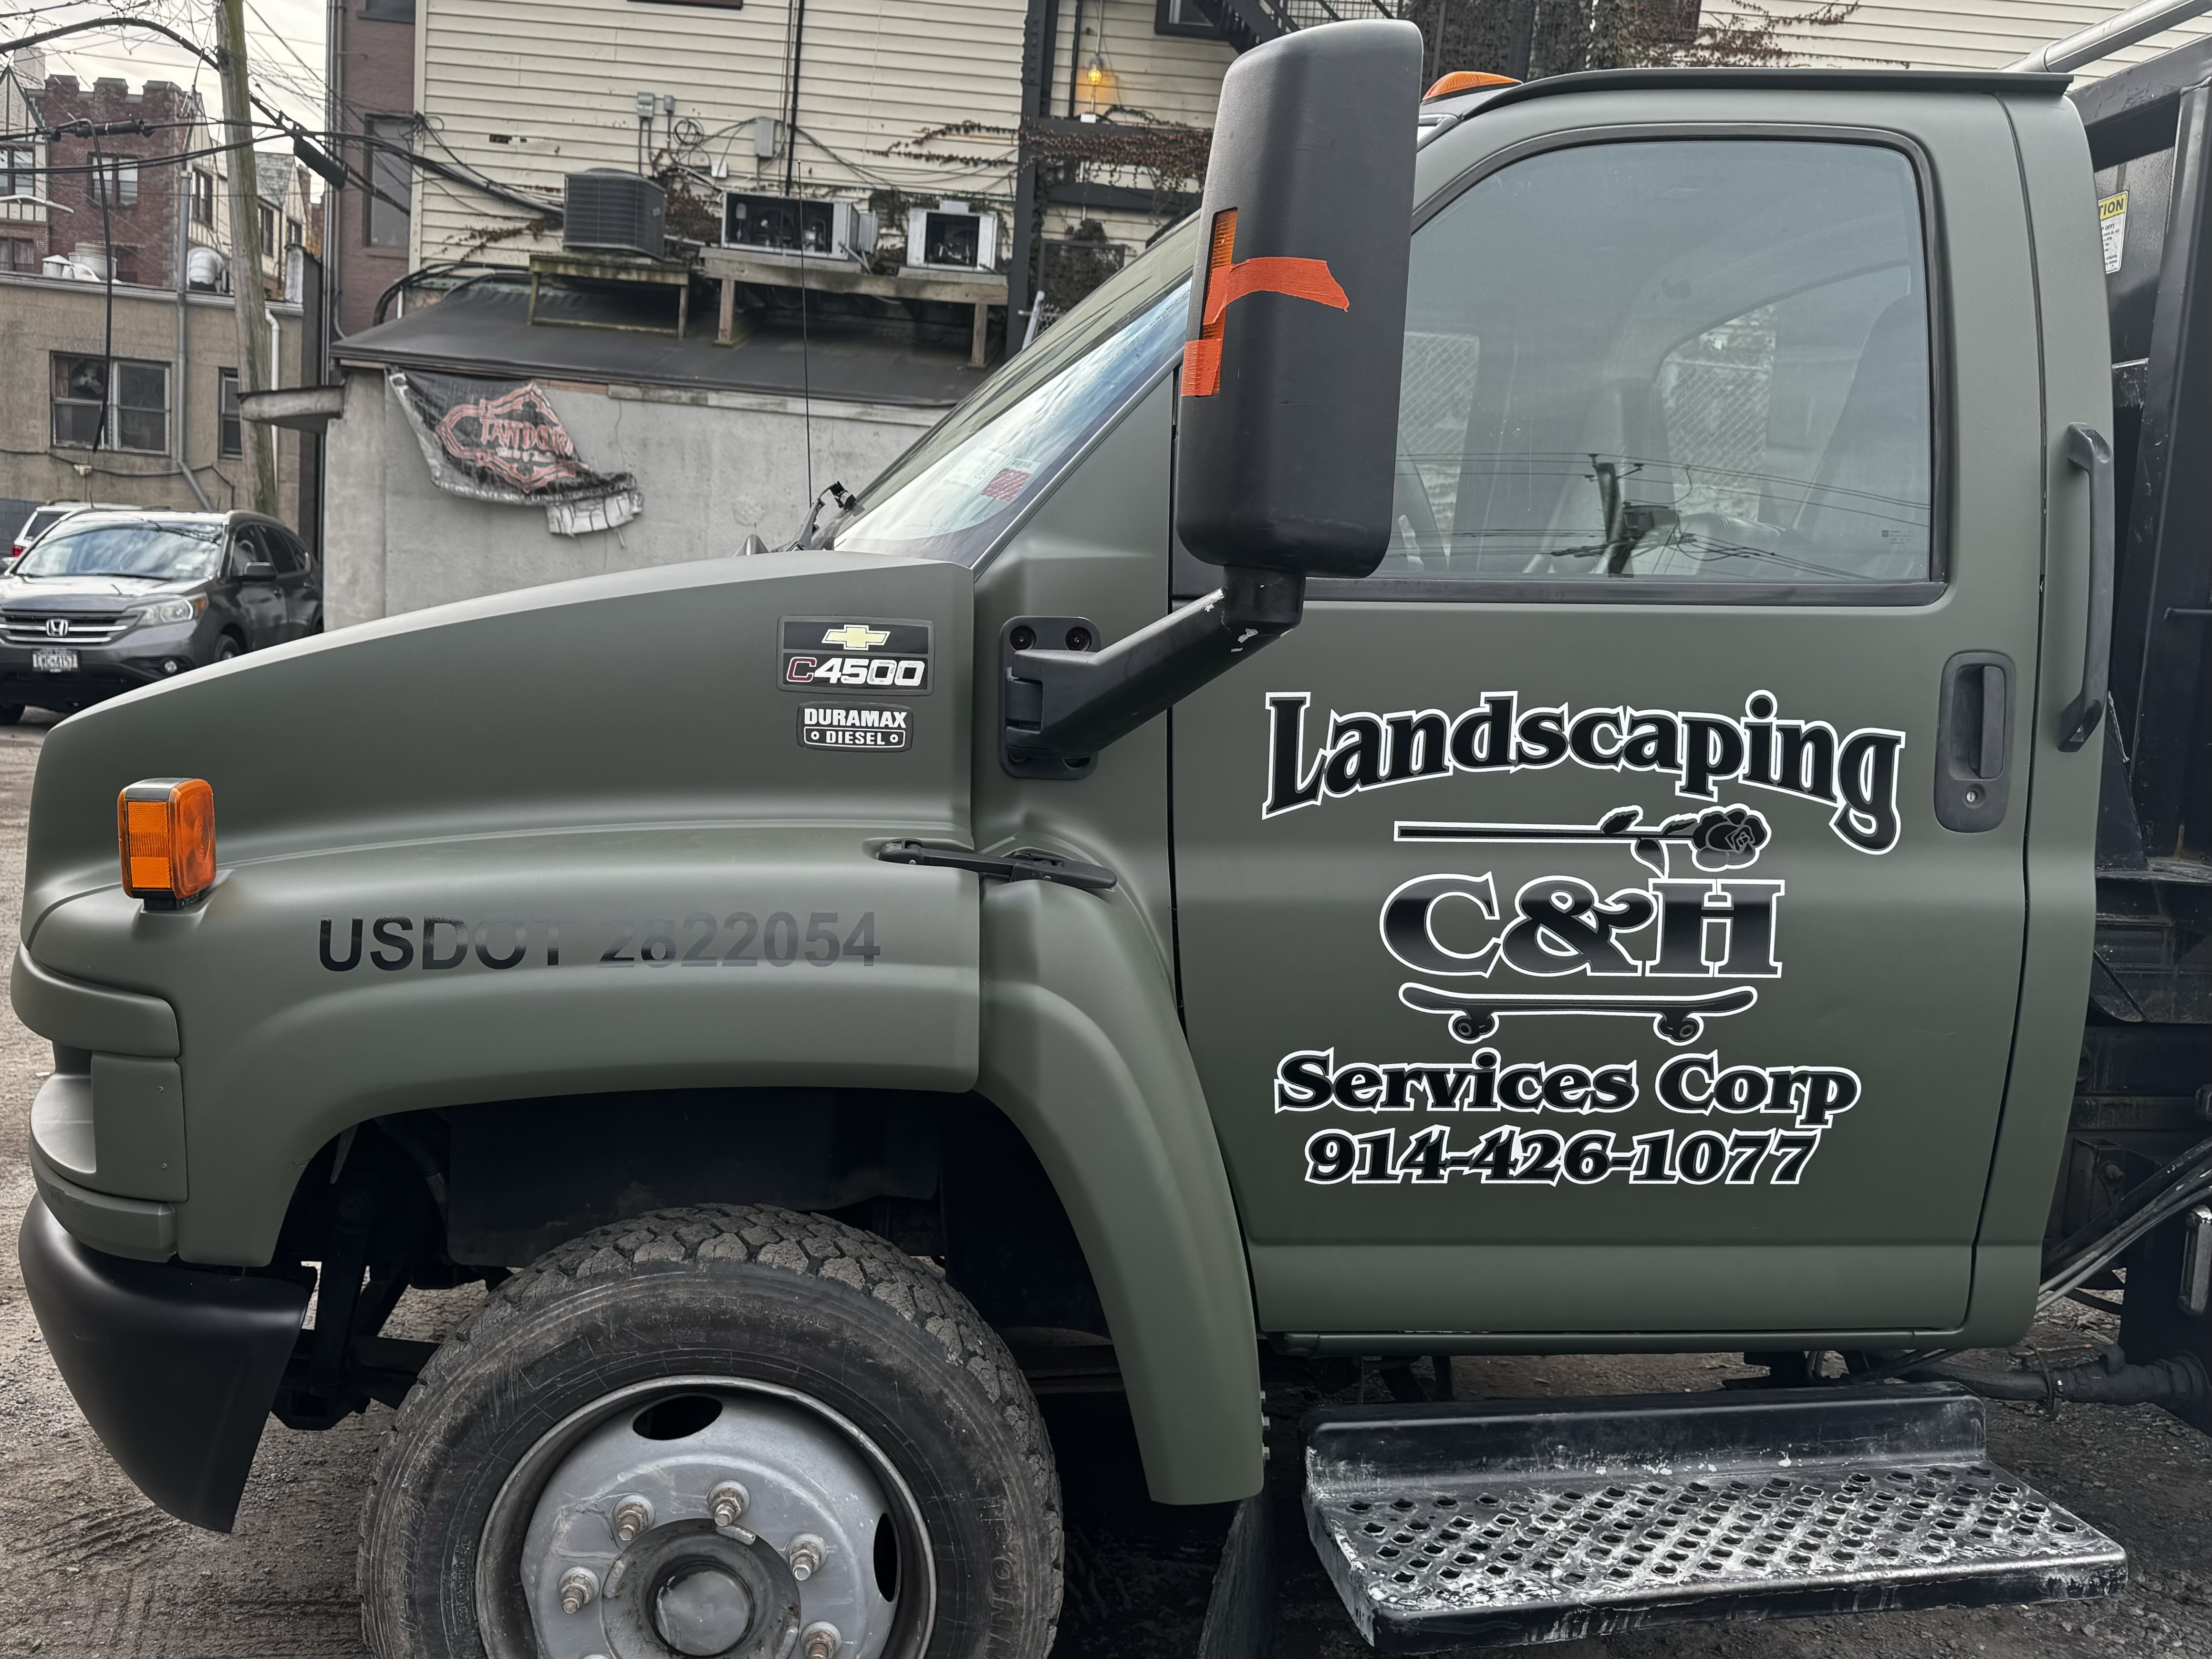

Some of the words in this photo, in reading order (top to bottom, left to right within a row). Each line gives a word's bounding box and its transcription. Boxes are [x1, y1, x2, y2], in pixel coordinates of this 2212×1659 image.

[786, 656, 925, 686] C4500
[804, 708, 908, 728] DURAMAX
[826, 730, 885, 746] DIESEL
[1262, 689, 1906, 855] Landscaping
[319, 913, 574, 972] USDOT
[598, 911, 882, 968] 2822054
[1379, 871, 1786, 978] C&H
[1274, 1047, 1638, 1114] Services
[1654, 1052, 1862, 1129] Corp
[1304, 1124, 1825, 1185] 914-426-1077
